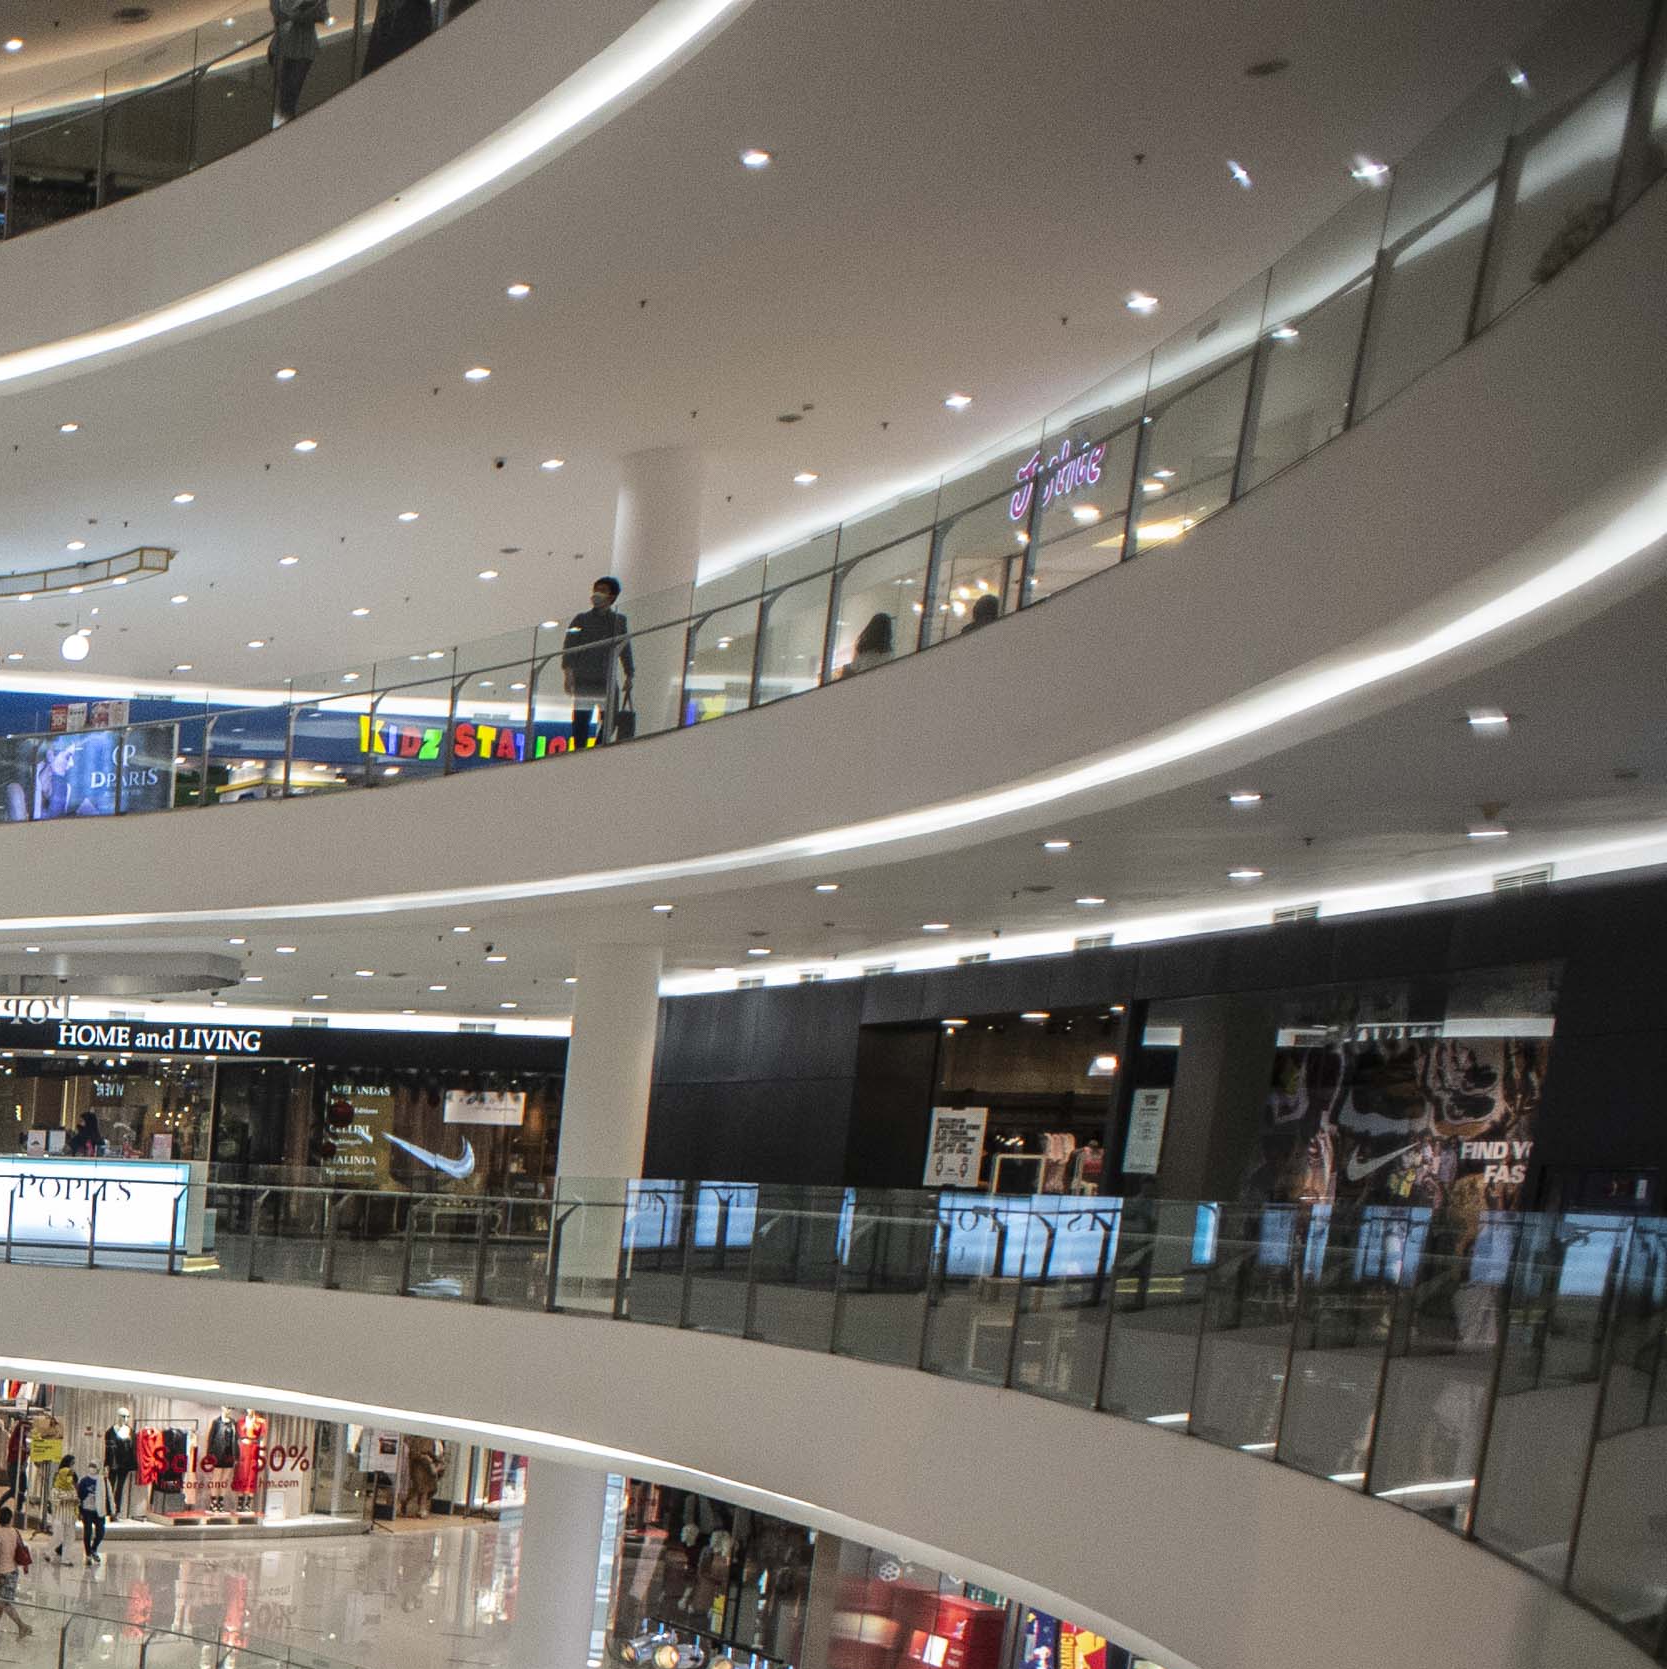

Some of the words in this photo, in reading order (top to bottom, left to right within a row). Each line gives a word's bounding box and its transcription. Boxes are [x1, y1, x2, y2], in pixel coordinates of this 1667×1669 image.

[359, 715, 444, 761] KIDZ
[58, 1024, 131, 1047] HOME
[135, 1029, 174, 1049] and
[179, 1029, 262, 1052] LIVING
[1460, 1142, 1509, 1160] FIND
[153, 1446, 216, 1473] Sale
